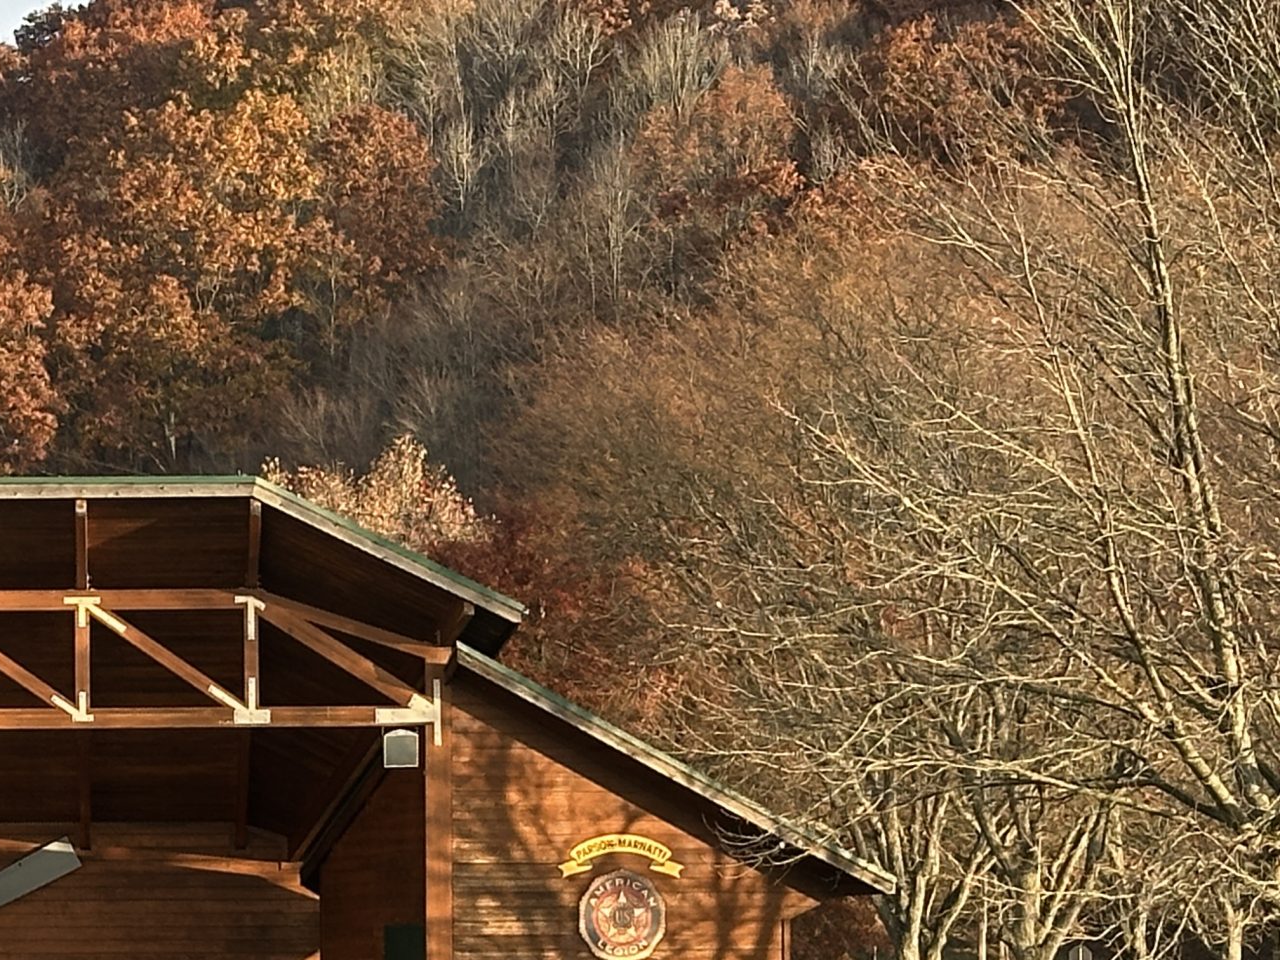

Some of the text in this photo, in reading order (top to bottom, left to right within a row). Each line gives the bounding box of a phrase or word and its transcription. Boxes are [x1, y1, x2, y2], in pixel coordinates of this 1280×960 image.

[589, 878, 658, 908] AMERICAN
[614, 910, 631, 924] US
[597, 939, 649, 956] LEGION
